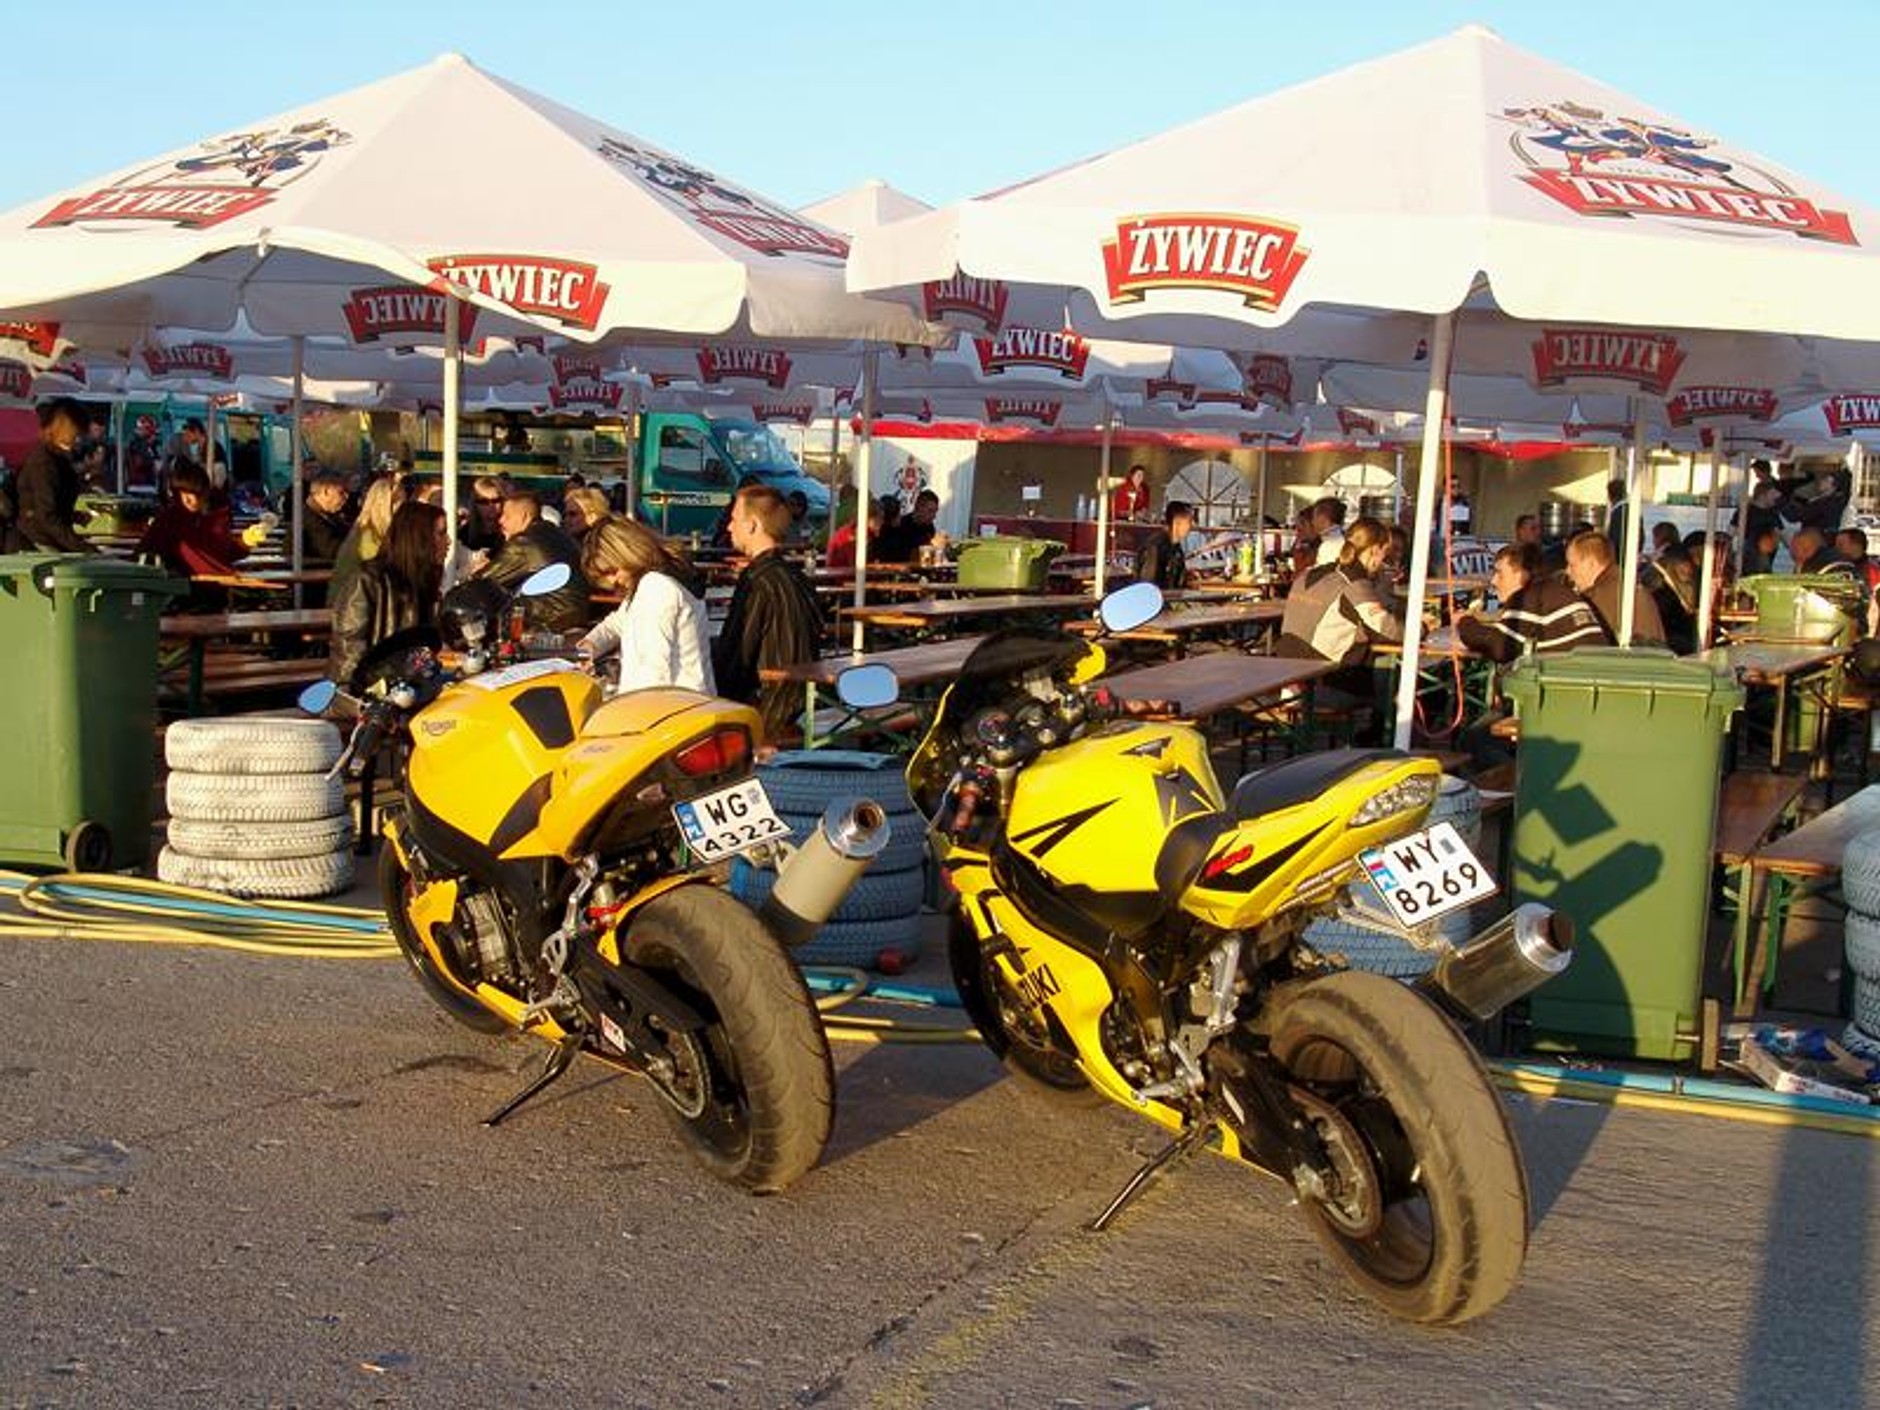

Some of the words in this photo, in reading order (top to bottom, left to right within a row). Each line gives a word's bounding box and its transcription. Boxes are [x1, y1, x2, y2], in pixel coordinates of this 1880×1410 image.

[1129, 219, 1283, 281] ŻYWIEC
[705, 793, 748, 826] WG
[705, 818, 781, 852] 4322
[1393, 838, 1440, 873] WY
[1395, 862, 1477, 914] 8269
